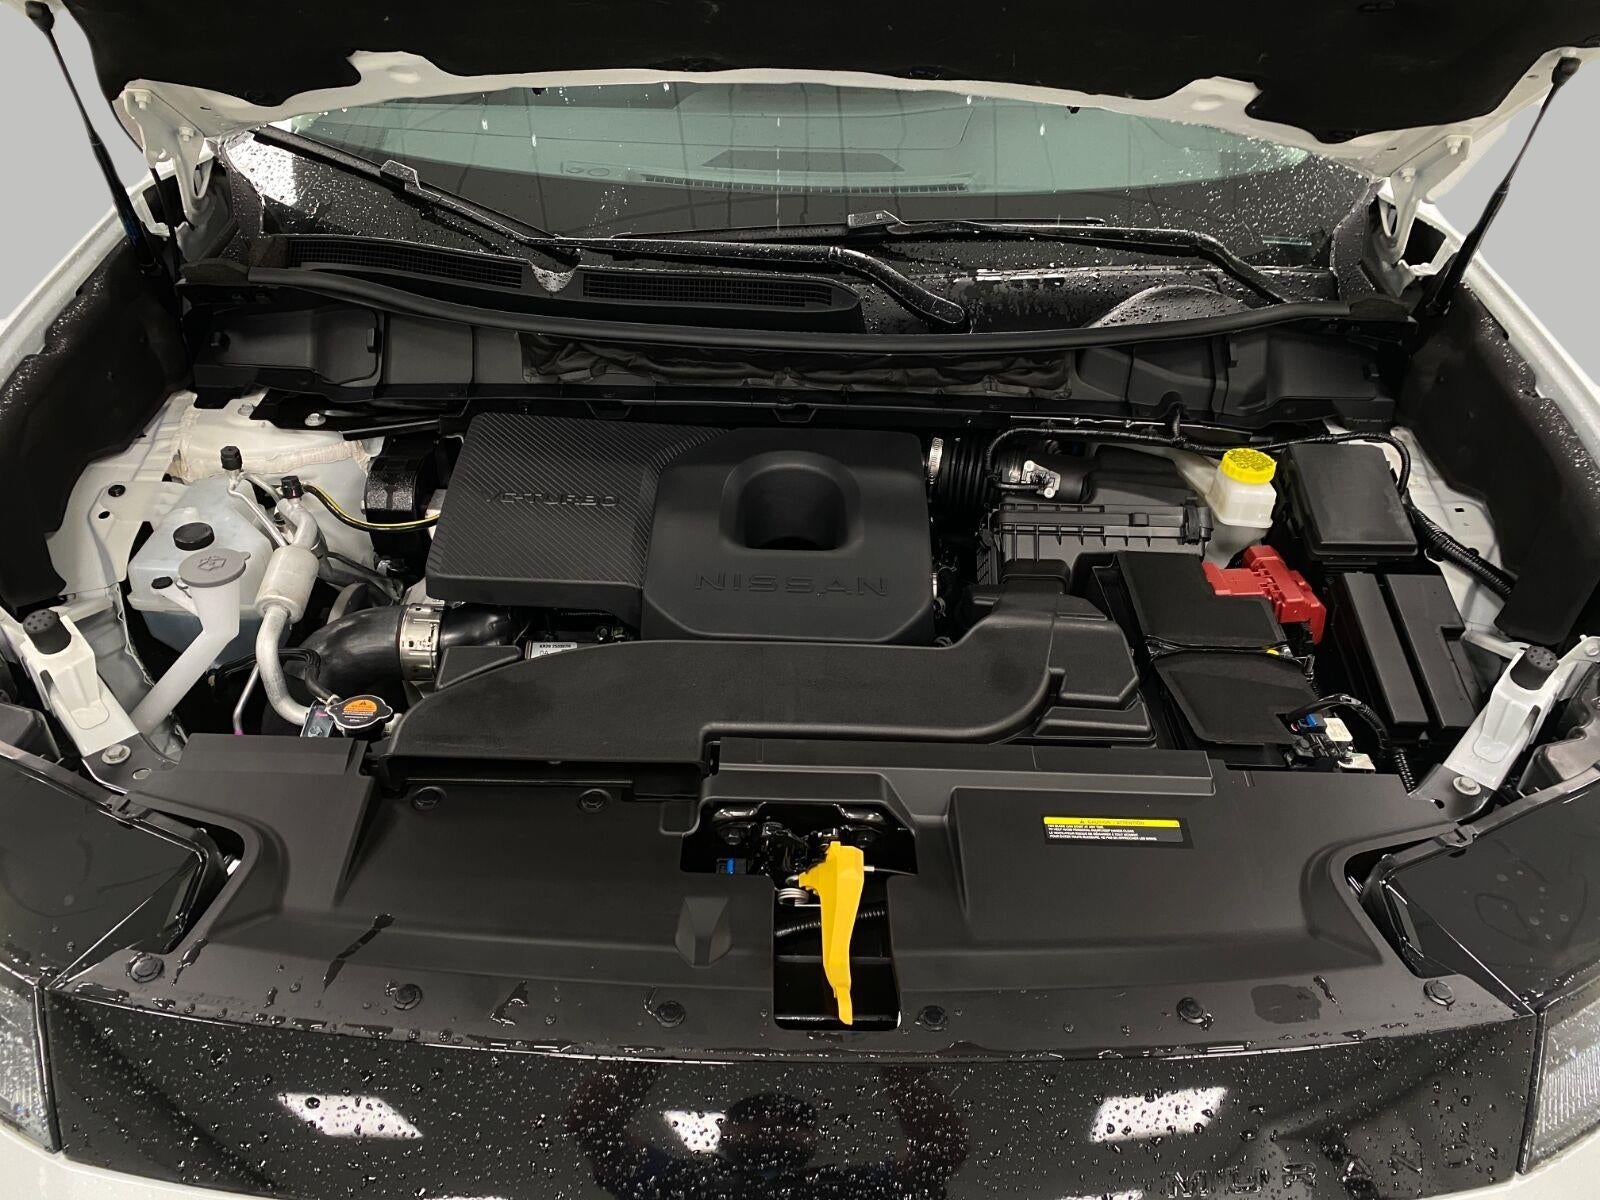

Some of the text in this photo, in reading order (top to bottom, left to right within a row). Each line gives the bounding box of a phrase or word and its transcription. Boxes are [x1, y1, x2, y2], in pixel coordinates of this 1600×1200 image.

[483, 491, 619, 507] VC-TURBO
[695, 571, 889, 596] NISSAN
[1167, 1143, 1474, 1198] MURANO
